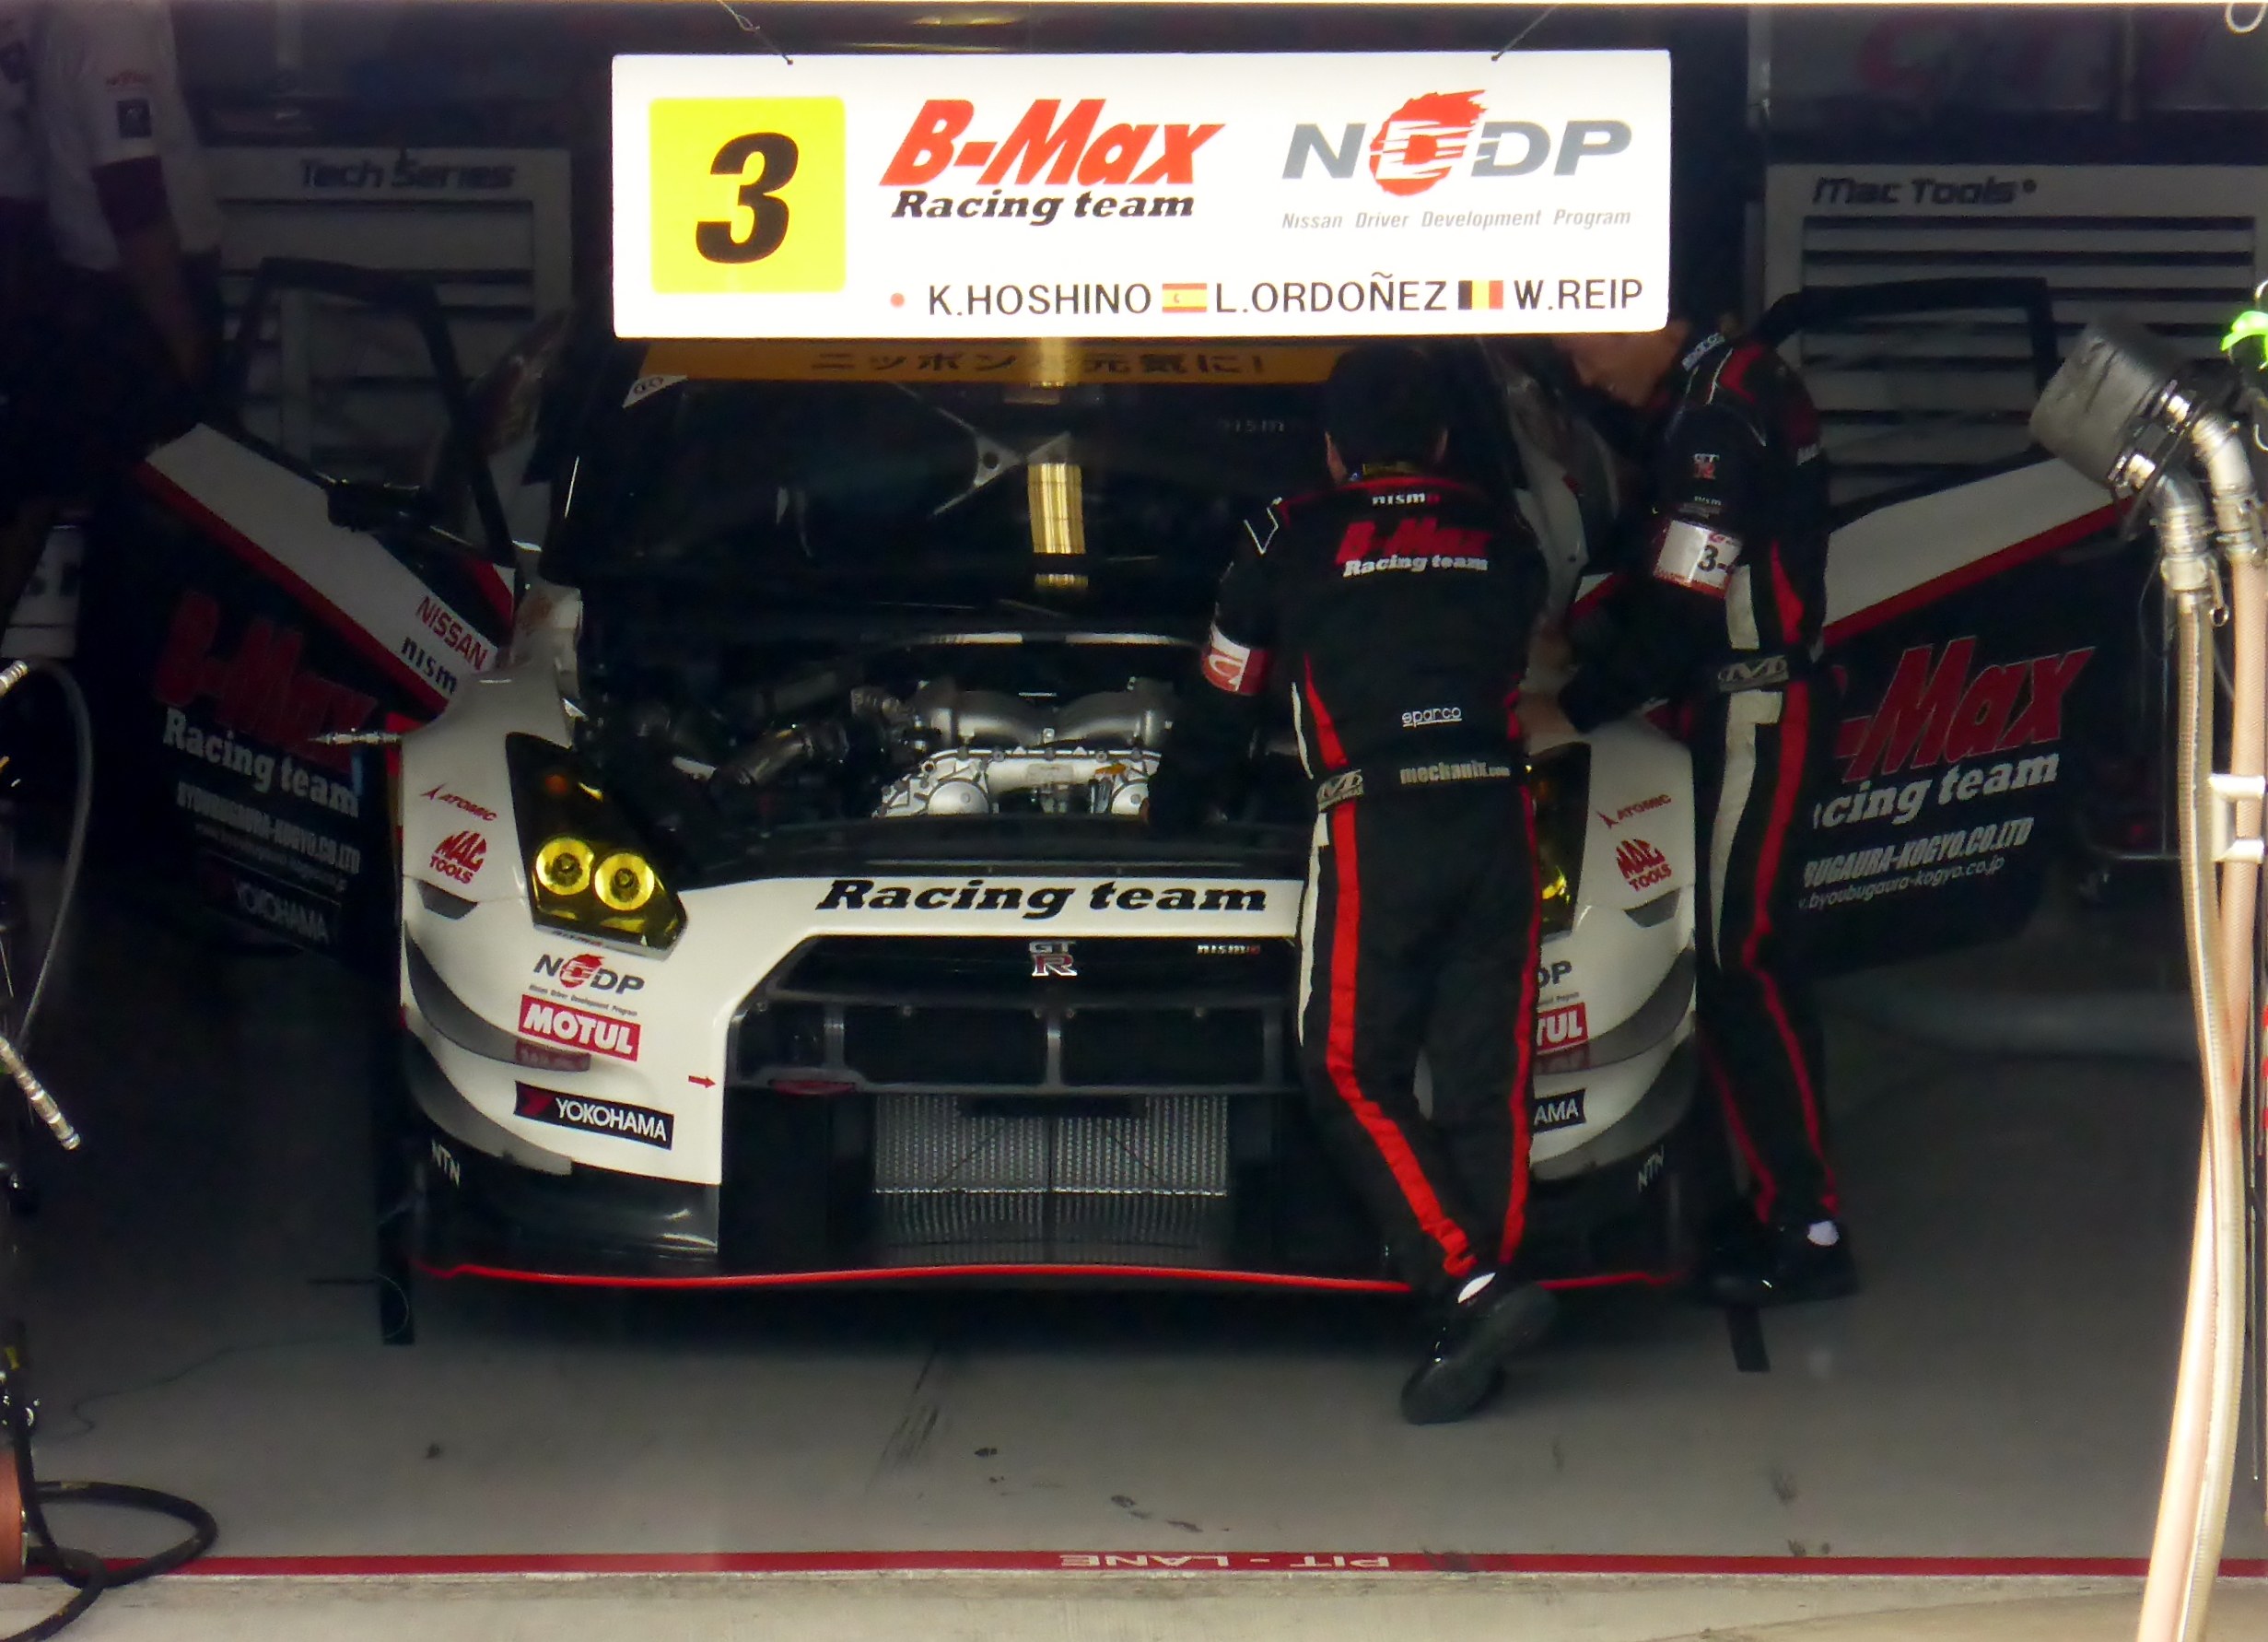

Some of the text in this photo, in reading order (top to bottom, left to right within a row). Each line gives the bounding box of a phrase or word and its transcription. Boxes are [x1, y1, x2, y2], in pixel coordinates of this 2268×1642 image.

[879, 99, 1225, 186] B-Max
[696, 132, 799, 264] 3
[890, 189, 1194, 227] Racing team
[1813, 178, 1899, 204] Mac
[1282, 208, 1631, 230] Nissan Driver Development Program
[929, 271, 1643, 316] K.HOSHINO L.ORDOÑEZ W.REIP
[1342, 554, 1489, 579] Racing team
[415, 596, 488, 671] NISSAN
[1401, 707, 1462, 728] sparco
[1832, 635, 2096, 783] -Max
[163, 707, 360, 818] Racing team
[1814, 753, 2060, 830] cing team
[428, 855, 473, 884] TOOLS
[434, 830, 486, 872] MAC
[1616, 839, 1666, 879] MAC
[1629, 864, 1672, 892] TOOLS
[815, 880, 1267, 919] Racing team
[523, 1003, 633, 1055] MOTUL
[1537, 1009, 1583, 1047] TUL
[555, 1097, 667, 1142] YOKOHAMA
[430, 1139, 461, 1188] NTN
[1059, 1554, 1229, 1566] LANE
[1290, 1554, 1389, 1566] PIT
